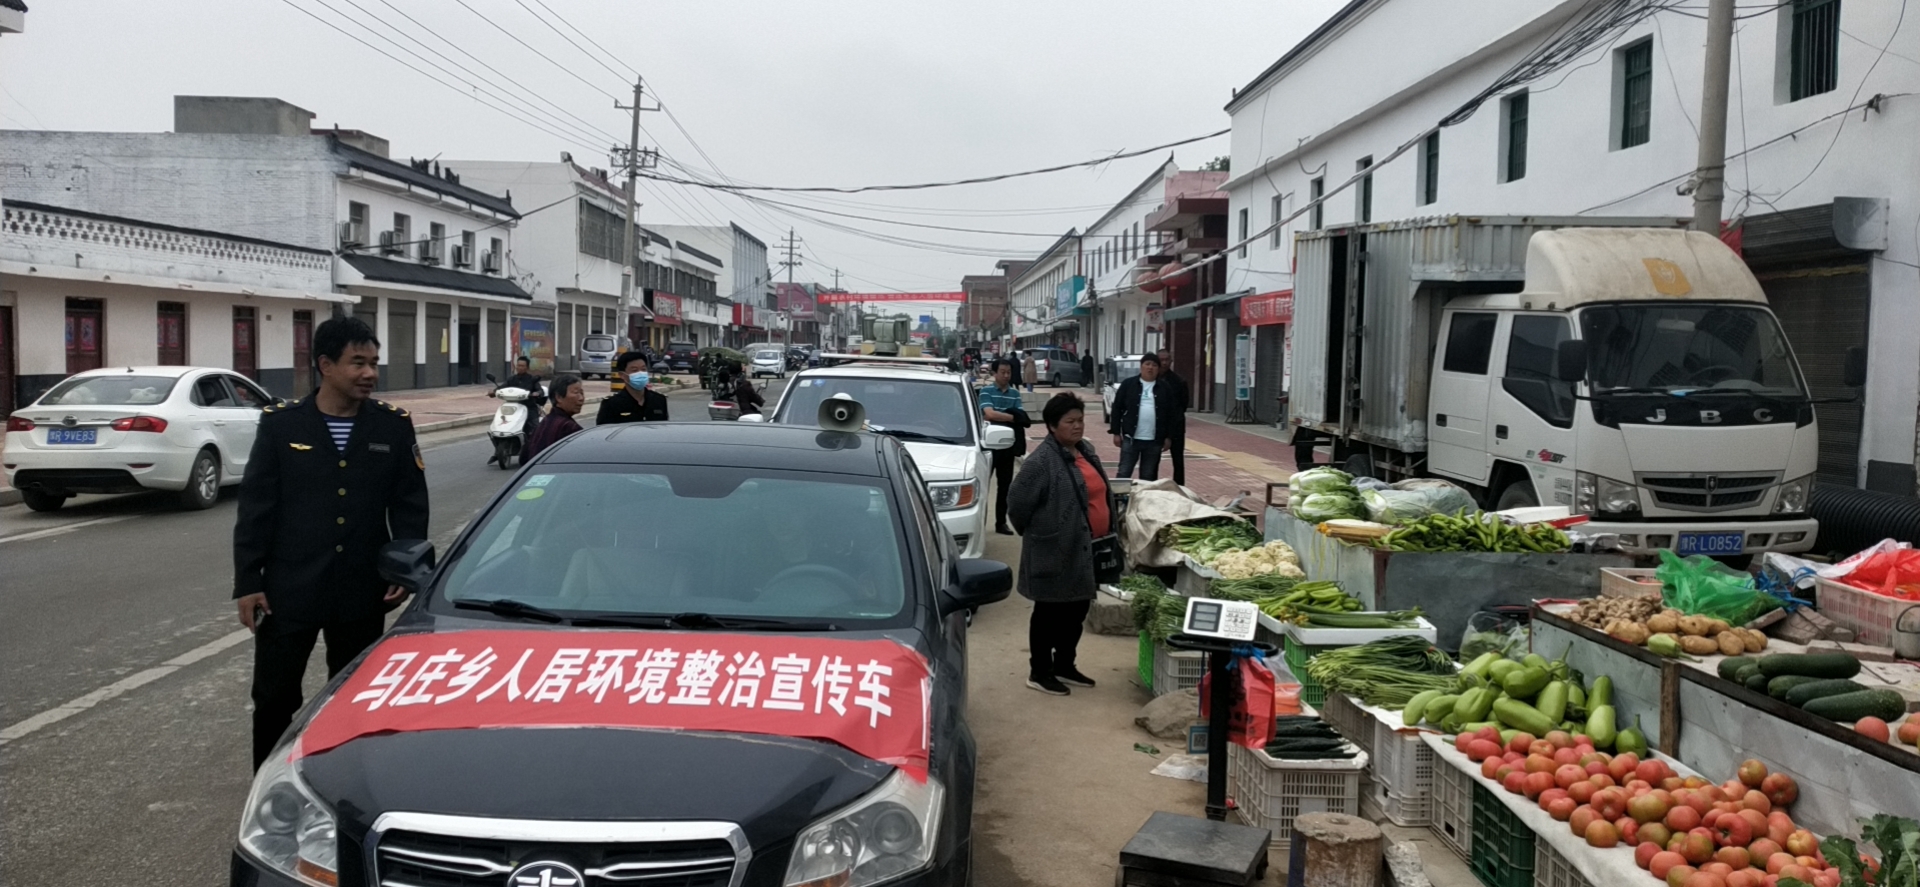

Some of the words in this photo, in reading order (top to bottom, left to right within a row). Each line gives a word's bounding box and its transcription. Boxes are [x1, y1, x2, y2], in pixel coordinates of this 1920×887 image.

[351, 645, 893, 728] 马庄乡人居环境整治宣传车
